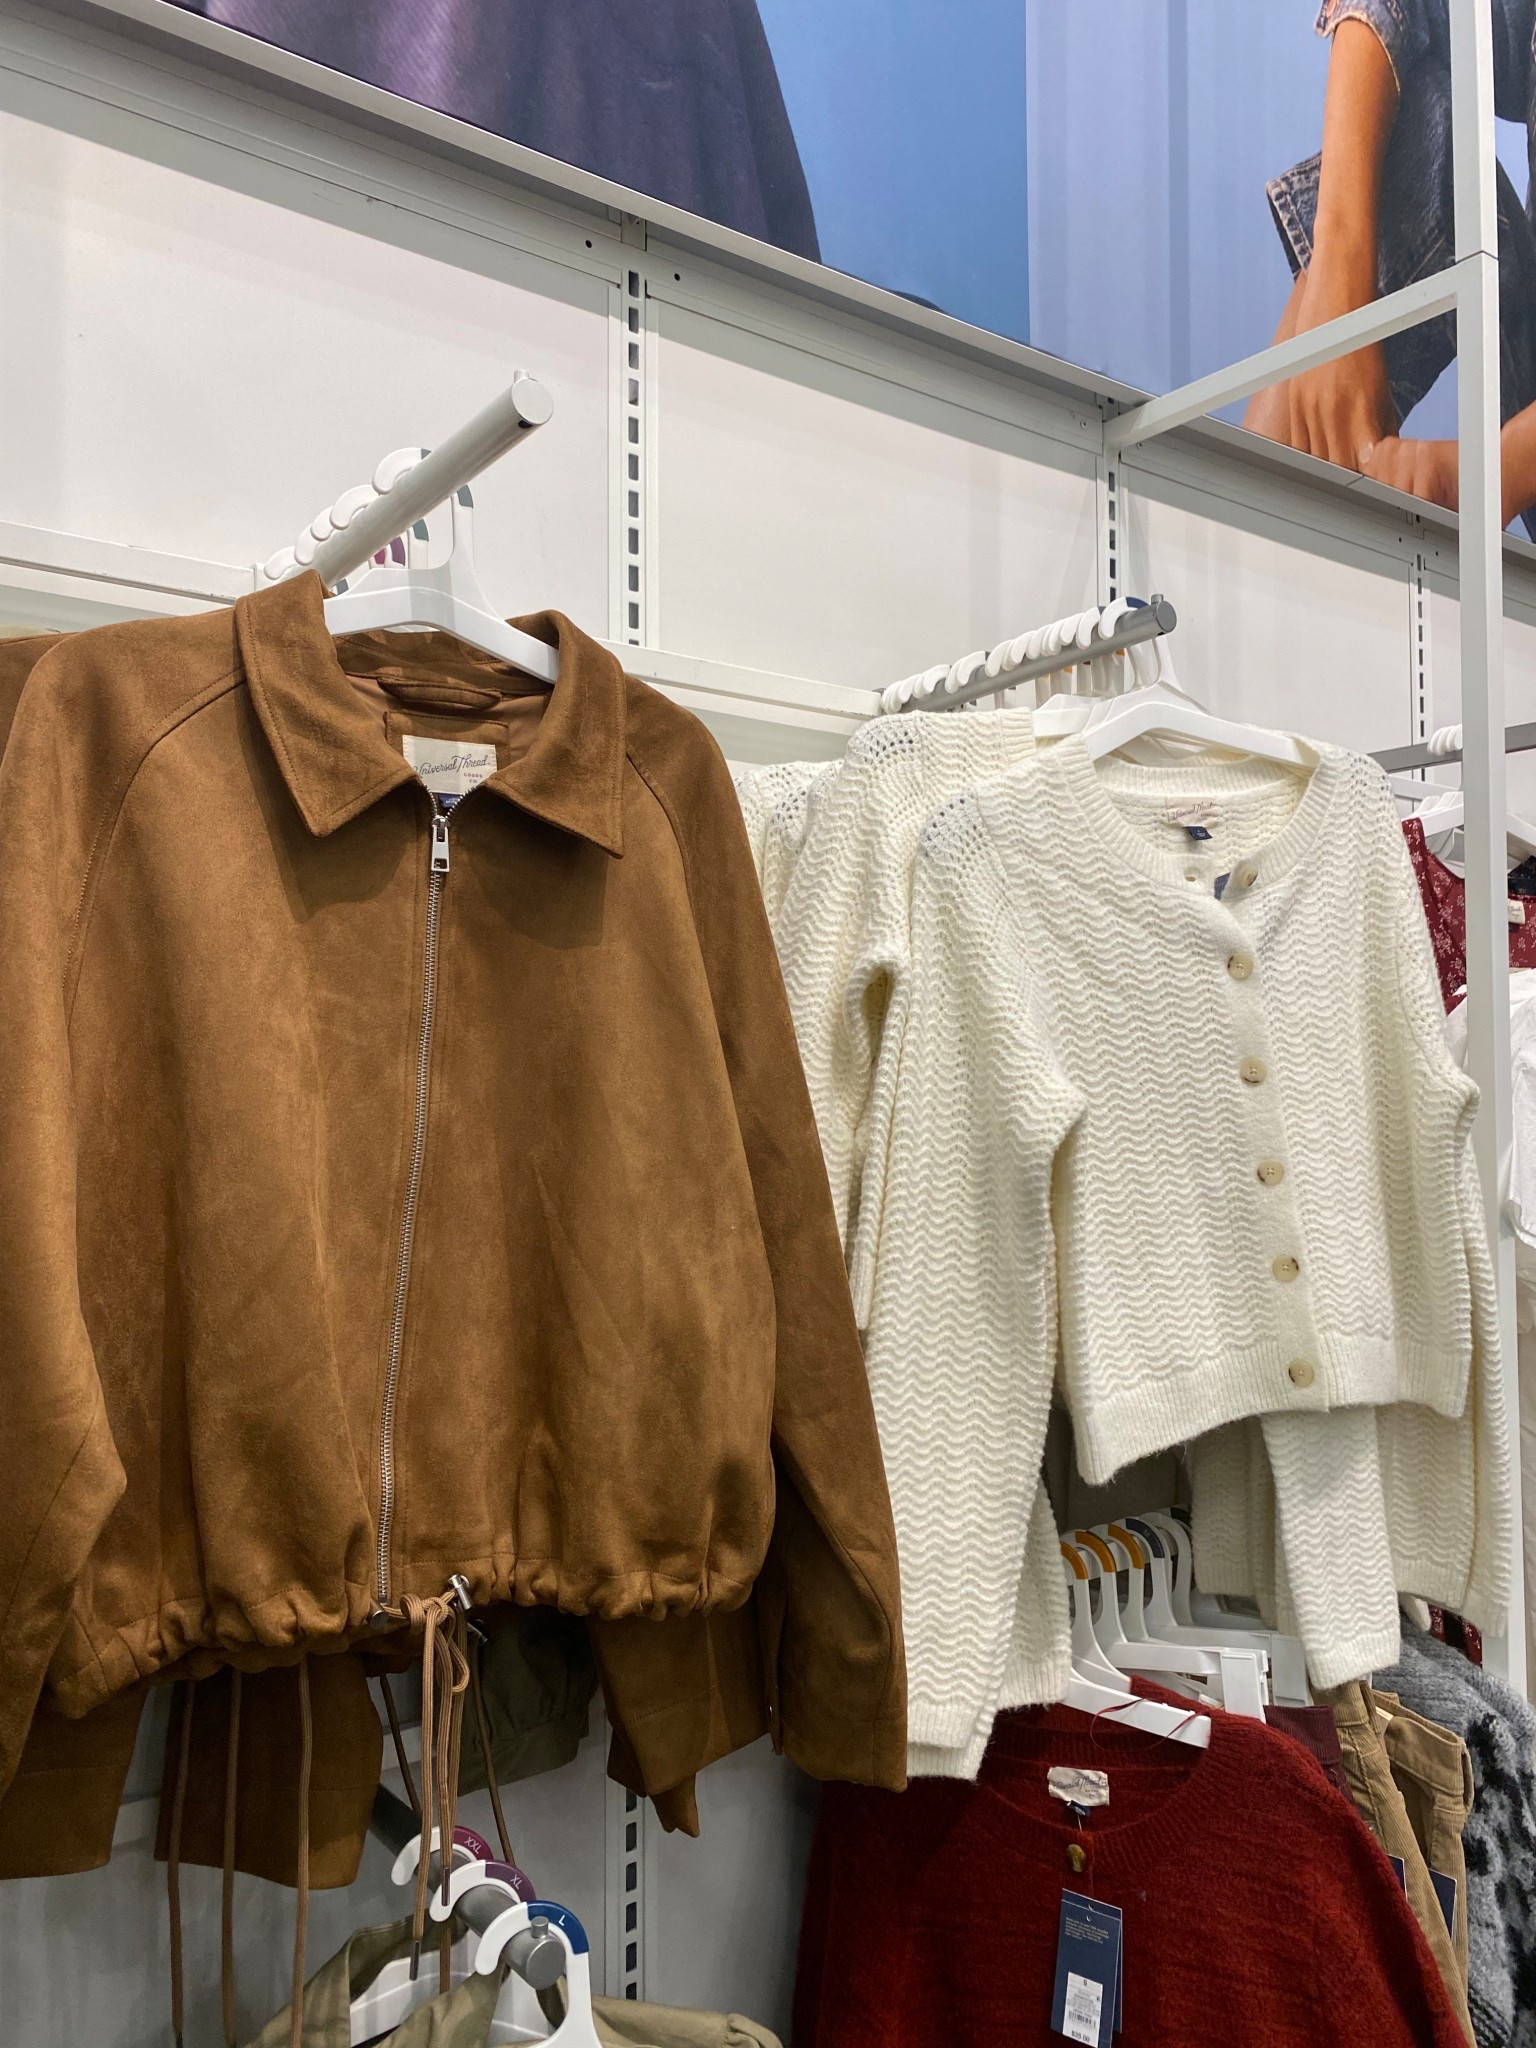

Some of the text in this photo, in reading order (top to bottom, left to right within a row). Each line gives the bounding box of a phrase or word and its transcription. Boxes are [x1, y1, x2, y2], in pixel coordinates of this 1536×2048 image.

[413, 753, 491, 778] Universal Thread
[464, 1837, 482, 1854] XXL
[510, 1875, 522, 1889] XL
[558, 1915, 565, 1926] L
